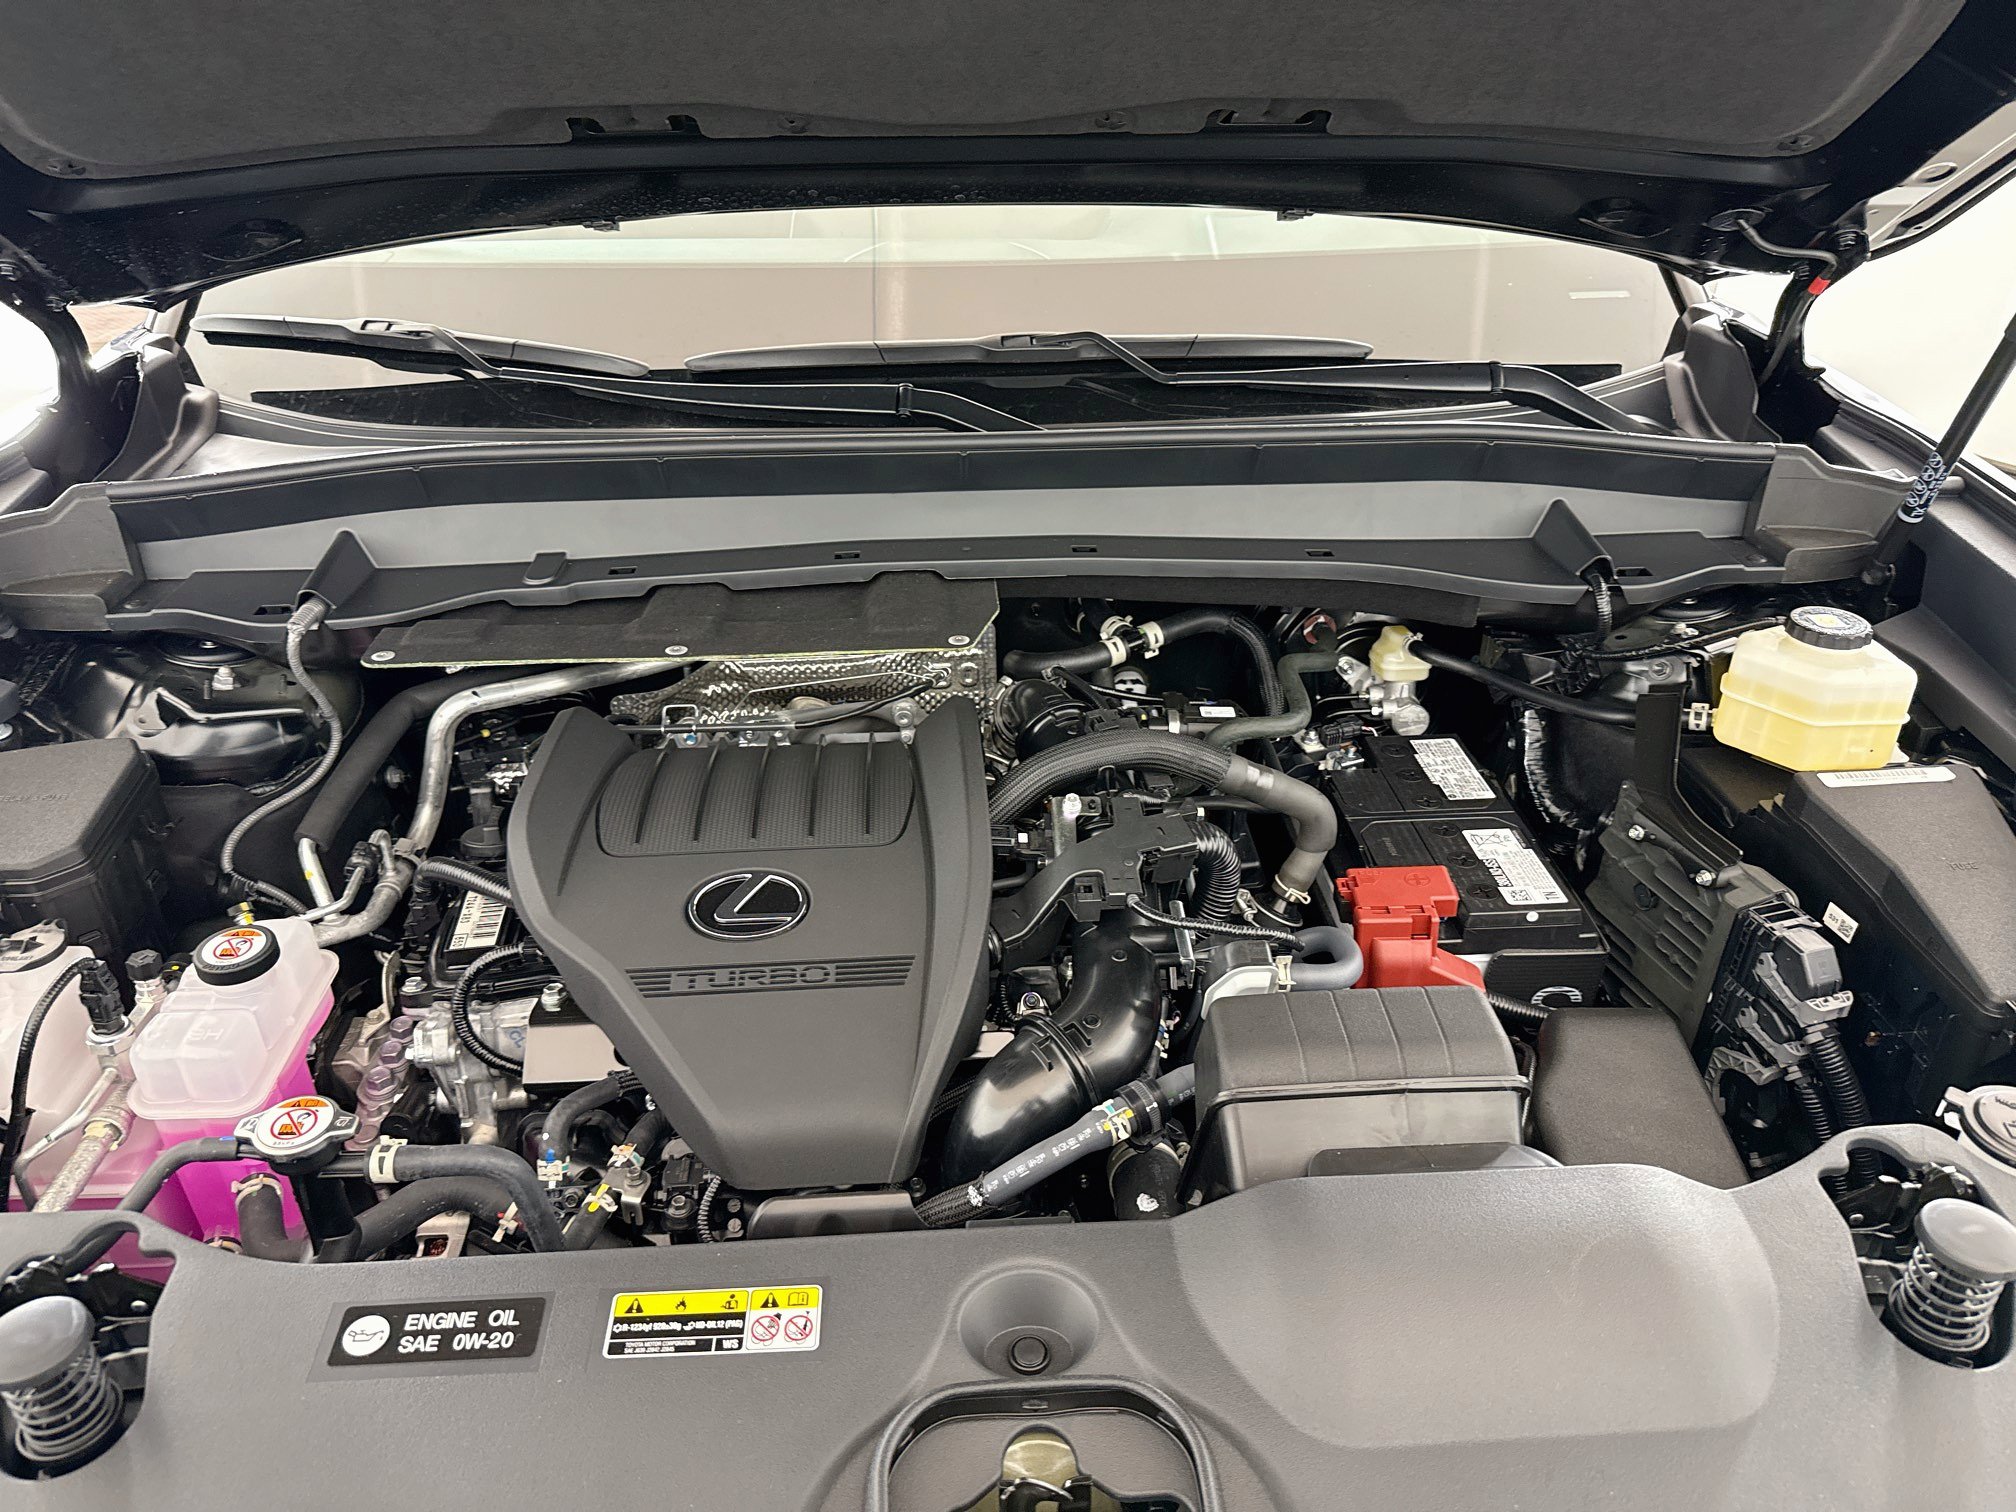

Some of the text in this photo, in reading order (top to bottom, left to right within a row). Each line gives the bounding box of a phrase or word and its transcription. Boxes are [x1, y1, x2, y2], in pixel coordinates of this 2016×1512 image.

[676, 964, 831, 989] TURBO
[403, 1308, 521, 1331] ENGINE OIL
[397, 1331, 515, 1354] SAE 0W-20
